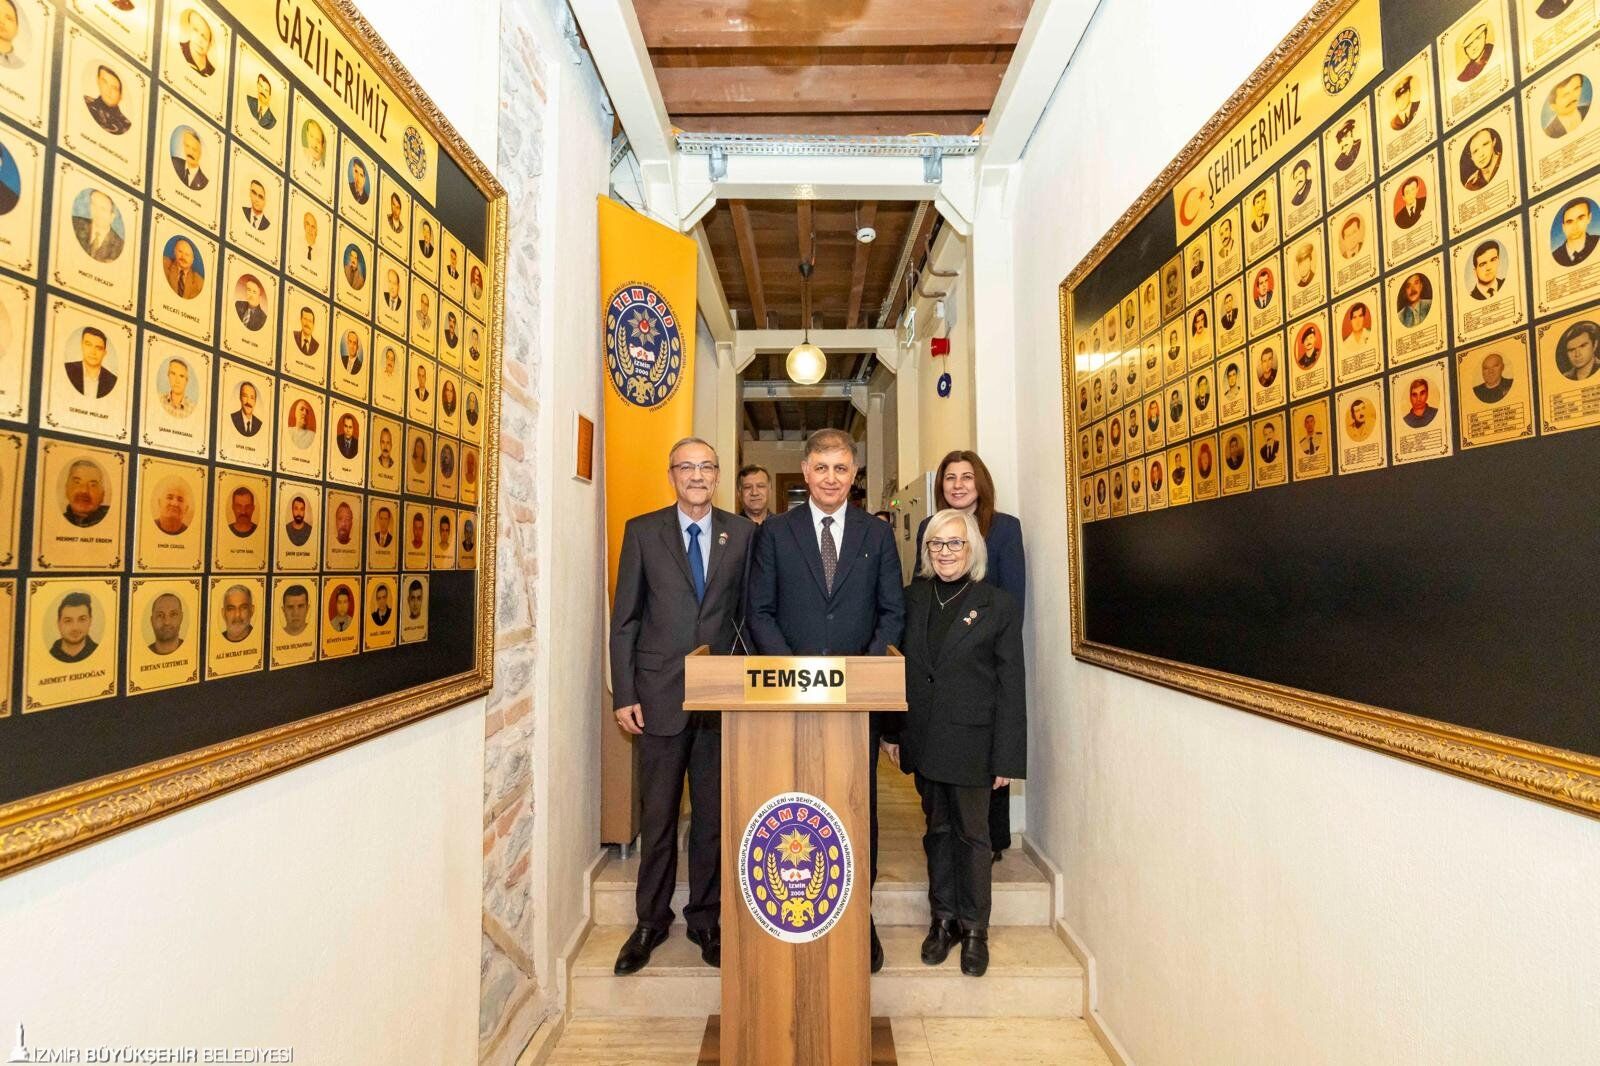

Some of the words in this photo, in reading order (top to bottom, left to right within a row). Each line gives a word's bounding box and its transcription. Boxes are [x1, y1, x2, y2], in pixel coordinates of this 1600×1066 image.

[275, 0, 388, 143] GAZİLERİMİZ
[1208, 82, 1301, 209] ŞEHİTLERİMİZ
[613, 289, 674, 327] TEMŞAD
[38, 675, 66, 686] AHMET
[68, 670, 106, 681] ERDOĞAN
[140, 663, 161, 672] ERTAN
[746, 669, 844, 692] TEMŞAD
[756, 808, 832, 839] TEMŞAD
[833, 821, 846, 843] SOSYAL
[740, 837, 750, 876] MENSUPLARI
[754, 910, 770, 929] EMNİYET
